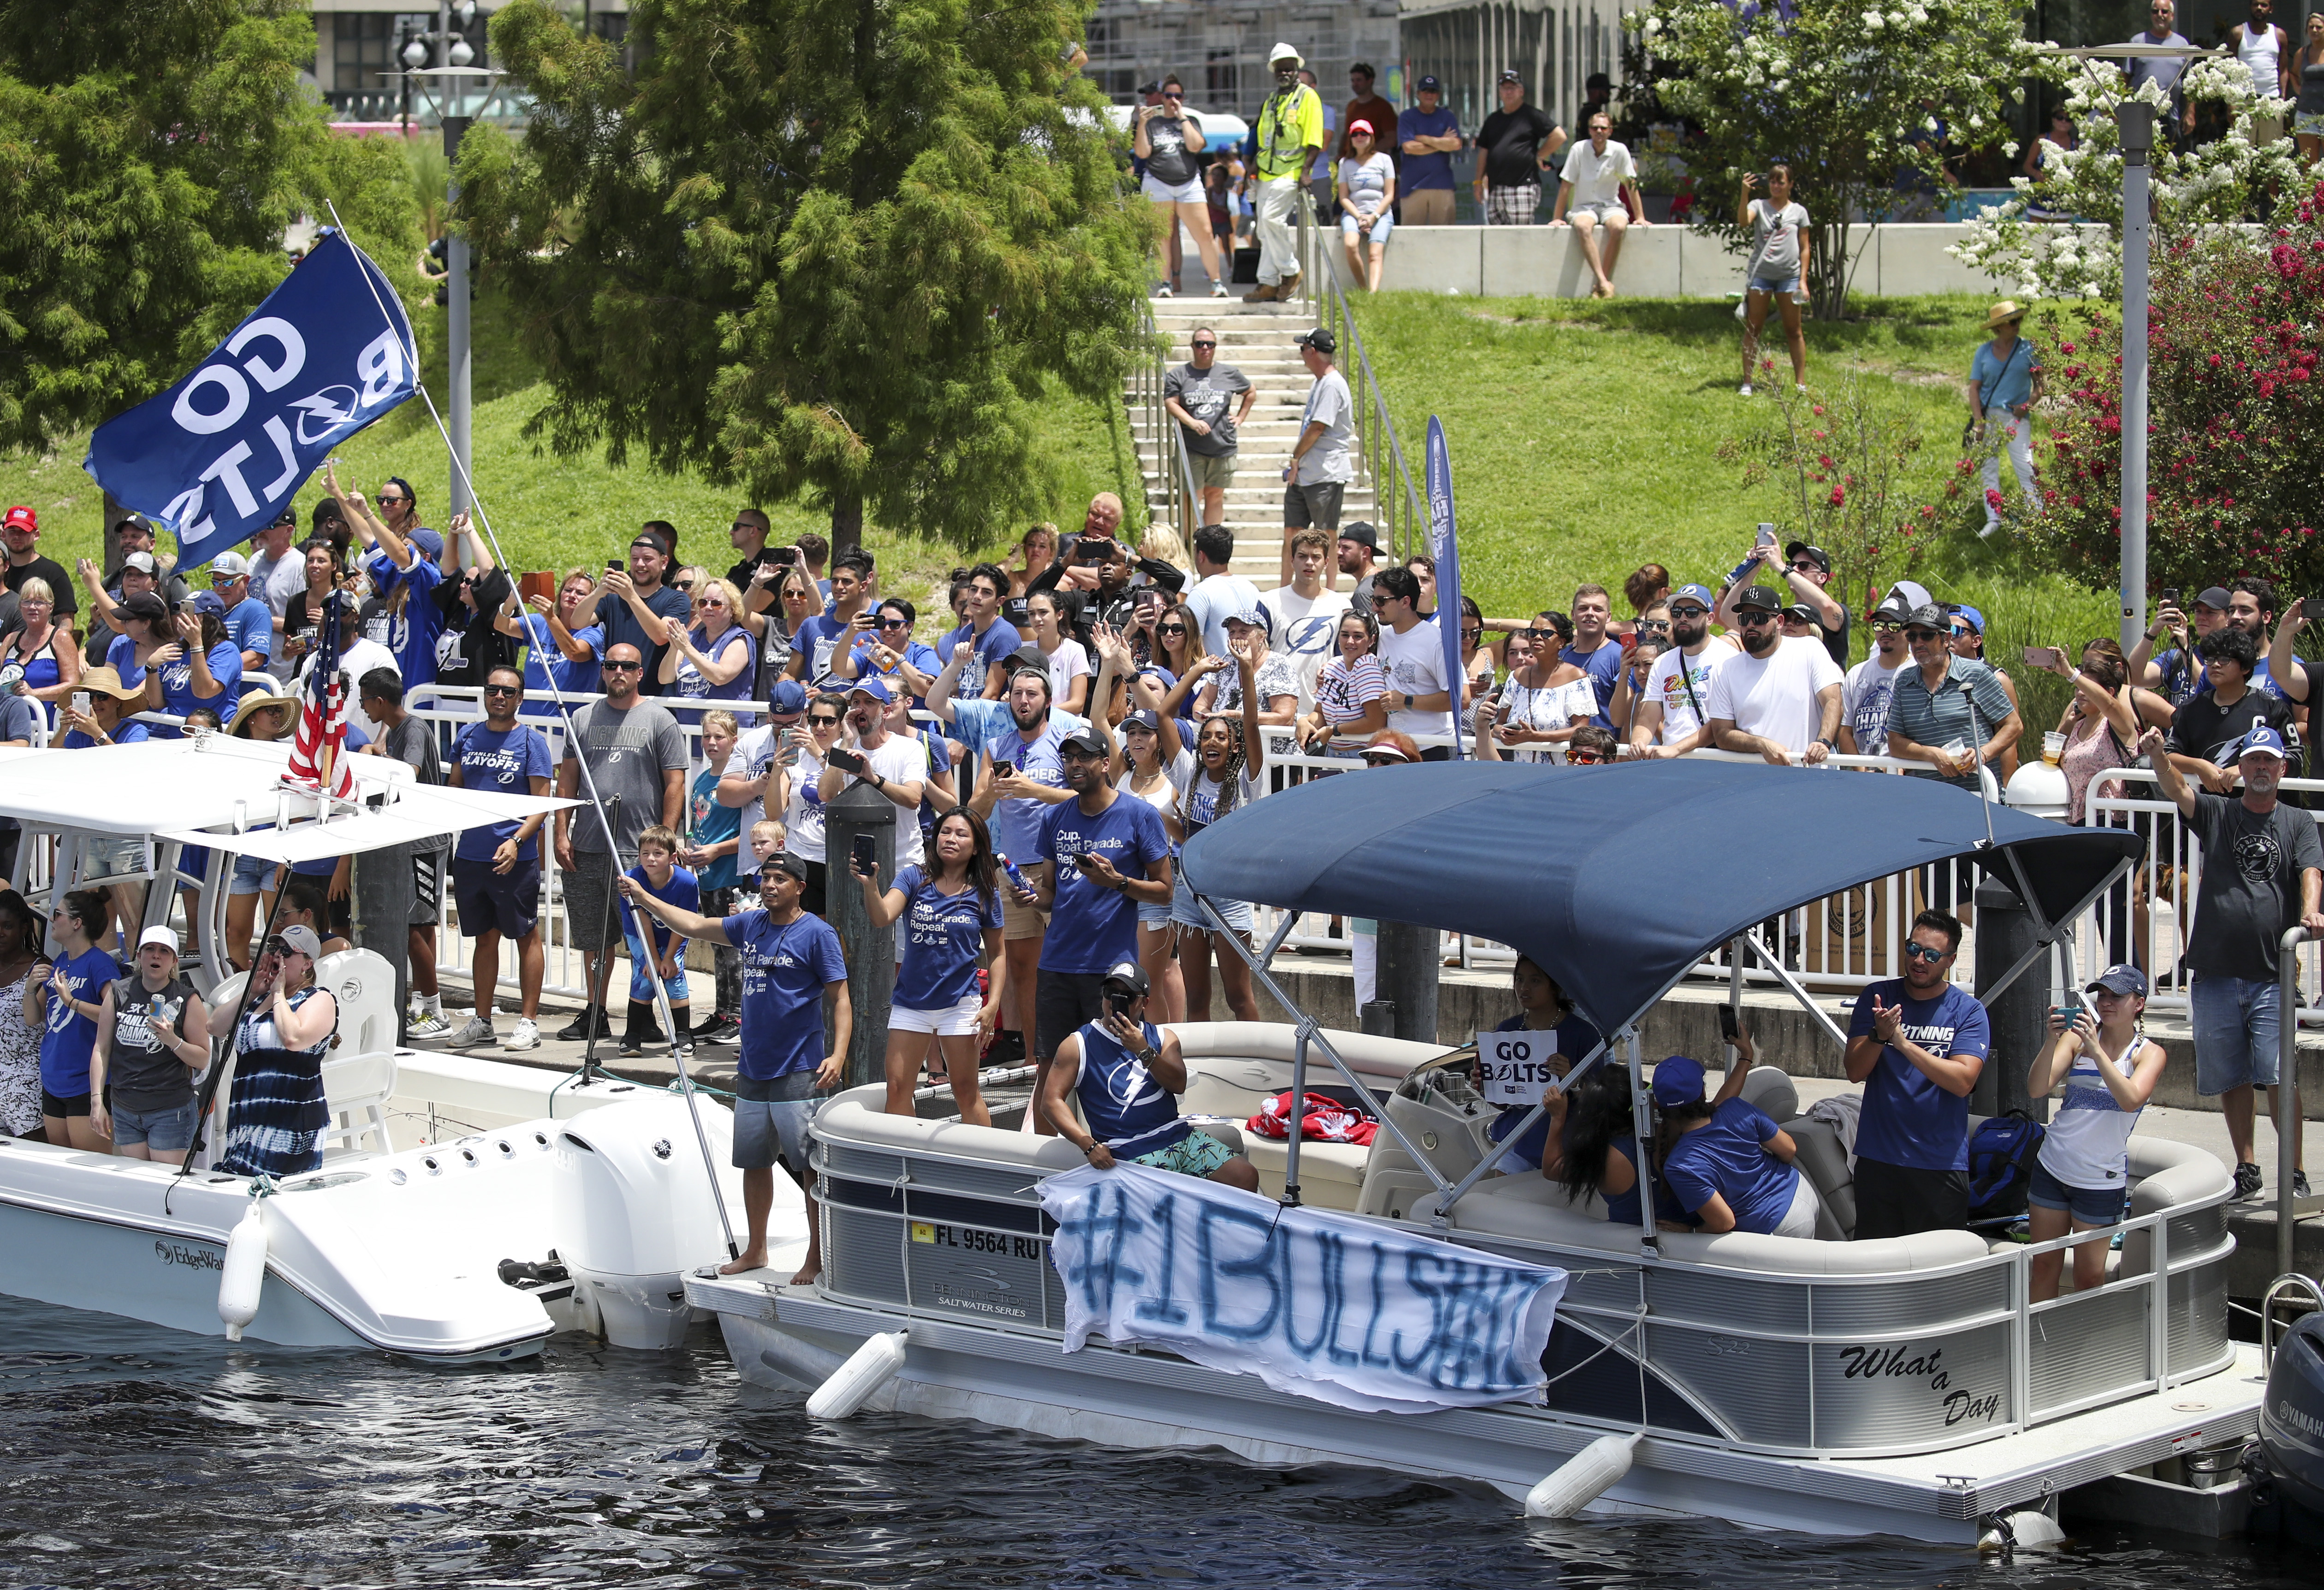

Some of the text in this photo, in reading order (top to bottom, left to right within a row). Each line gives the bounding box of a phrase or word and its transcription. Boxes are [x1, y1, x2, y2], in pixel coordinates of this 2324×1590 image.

[1185, 395, 1225, 405] CHAMPS
[588, 725, 648, 748] LIGHTNING
[461, 756, 521, 772] PLAYOFFS
[1055, 837, 1124, 852] Boat Parade.
[1056, 830, 1081, 843] Cup.
[1056, 853, 1076, 867] Rep
[2259, 838, 2278, 873] LIGHTNING
[1019, 870, 1030, 889] ULTRA
[914, 900, 934, 914] Cup.
[911, 909, 972, 924] Boat Parade.
[910, 919, 947, 932] Repeat.
[757, 954, 795, 966] Parade.
[743, 966, 766, 980] epeat.
[127, 1003, 144, 1014] 3X
[1496, 1041, 1531, 1061] GO
[937, 1225, 958, 1247] FL
[963, 1229, 1008, 1255] 9564
[1014, 1237, 1039, 1260] RU
[172, 1245, 225, 1271] EdgeWat
[933, 1283, 1031, 1308] BENNINGTON
[994, 1306, 1026, 1318] SERIES
[1705, 1335, 1751, 1356] S22
[1839, 1345, 1942, 1379] What
[1930, 1371, 1952, 1391] a
[1942, 1389, 2000, 1427] Day
